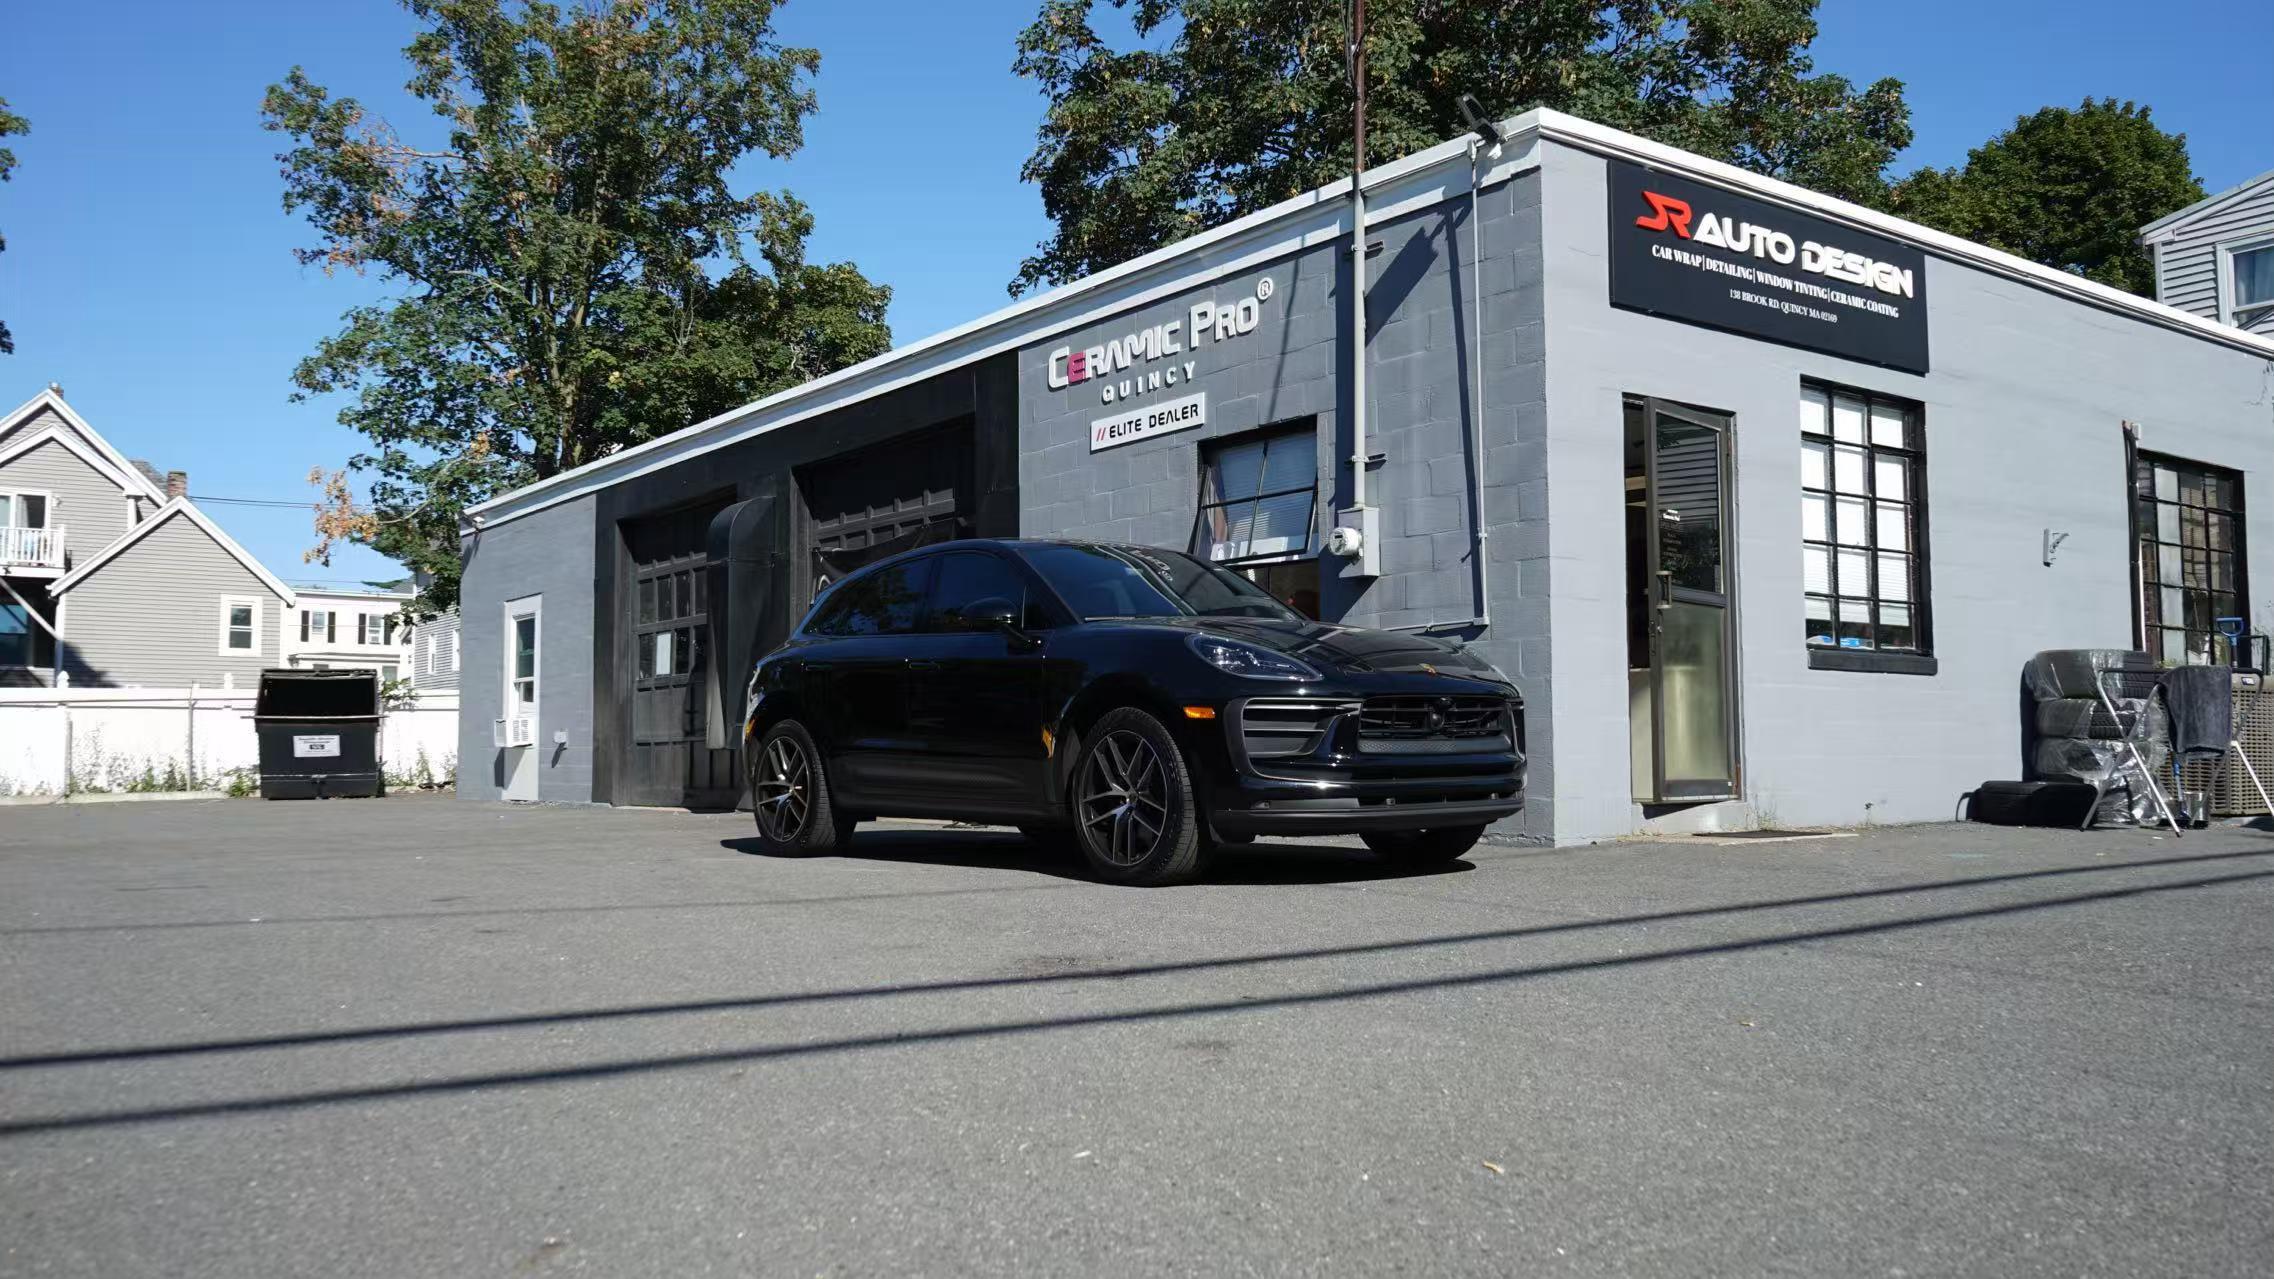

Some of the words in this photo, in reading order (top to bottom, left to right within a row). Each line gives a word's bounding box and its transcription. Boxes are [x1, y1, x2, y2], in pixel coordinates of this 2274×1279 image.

[1692, 212, 1796, 265] AUTO
[1801, 240, 1914, 300] DESIGN
[1651, 244, 1673, 261] CAR
[1673, 249, 1702, 267] WRAP
[1705, 257, 1753, 281] DETAILING
[1756, 270, 1793, 291] WINDOW
[1793, 280, 1828, 300] TINTING
[1830, 290, 1867, 310] CERAMIC
[1866, 299, 1900, 318] COATING
[1729, 289, 1741, 300] 138
[1741, 291, 1768, 306] BROOK
[1780, 301, 1808, 315] QUINCY
[1808, 308, 1821, 319] MA
[1101, 361, 1196, 403] QUINCY
[1109, 418, 1142, 438] ELITE
[1148, 403, 1199, 428] DEALER
